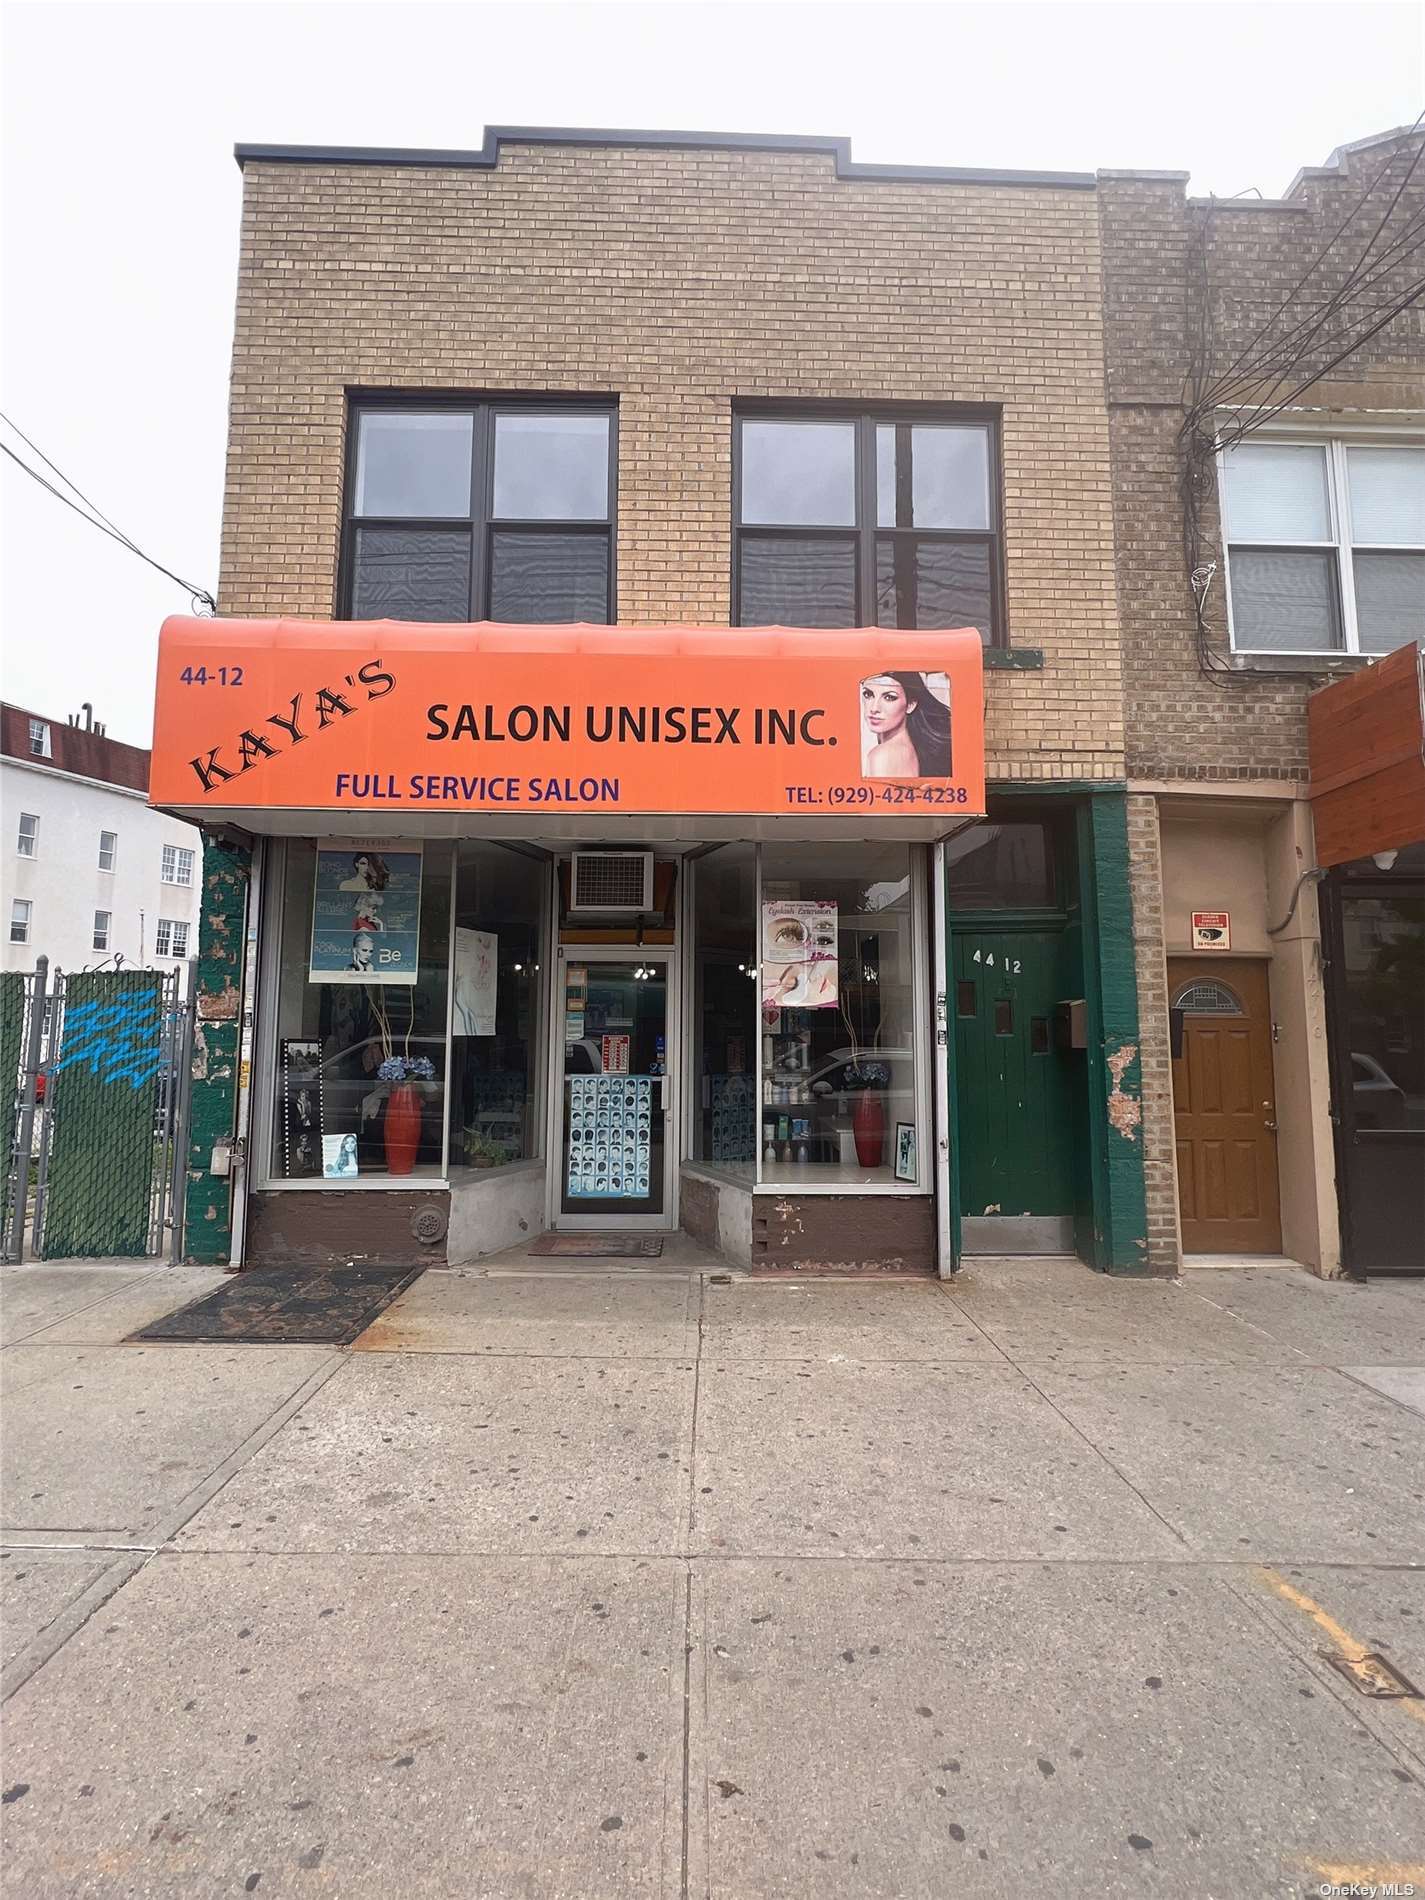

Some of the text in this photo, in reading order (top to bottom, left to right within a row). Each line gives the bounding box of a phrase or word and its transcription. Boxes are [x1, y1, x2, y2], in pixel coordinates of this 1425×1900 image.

[180, 667, 244, 686] 44-12
[188, 658, 397, 793] KAYA'S
[426, 704, 838, 746] SALON UNISEX INC.
[336, 774, 620, 801] FULL SERVICE SALON
[378, 948, 401, 963] Be
